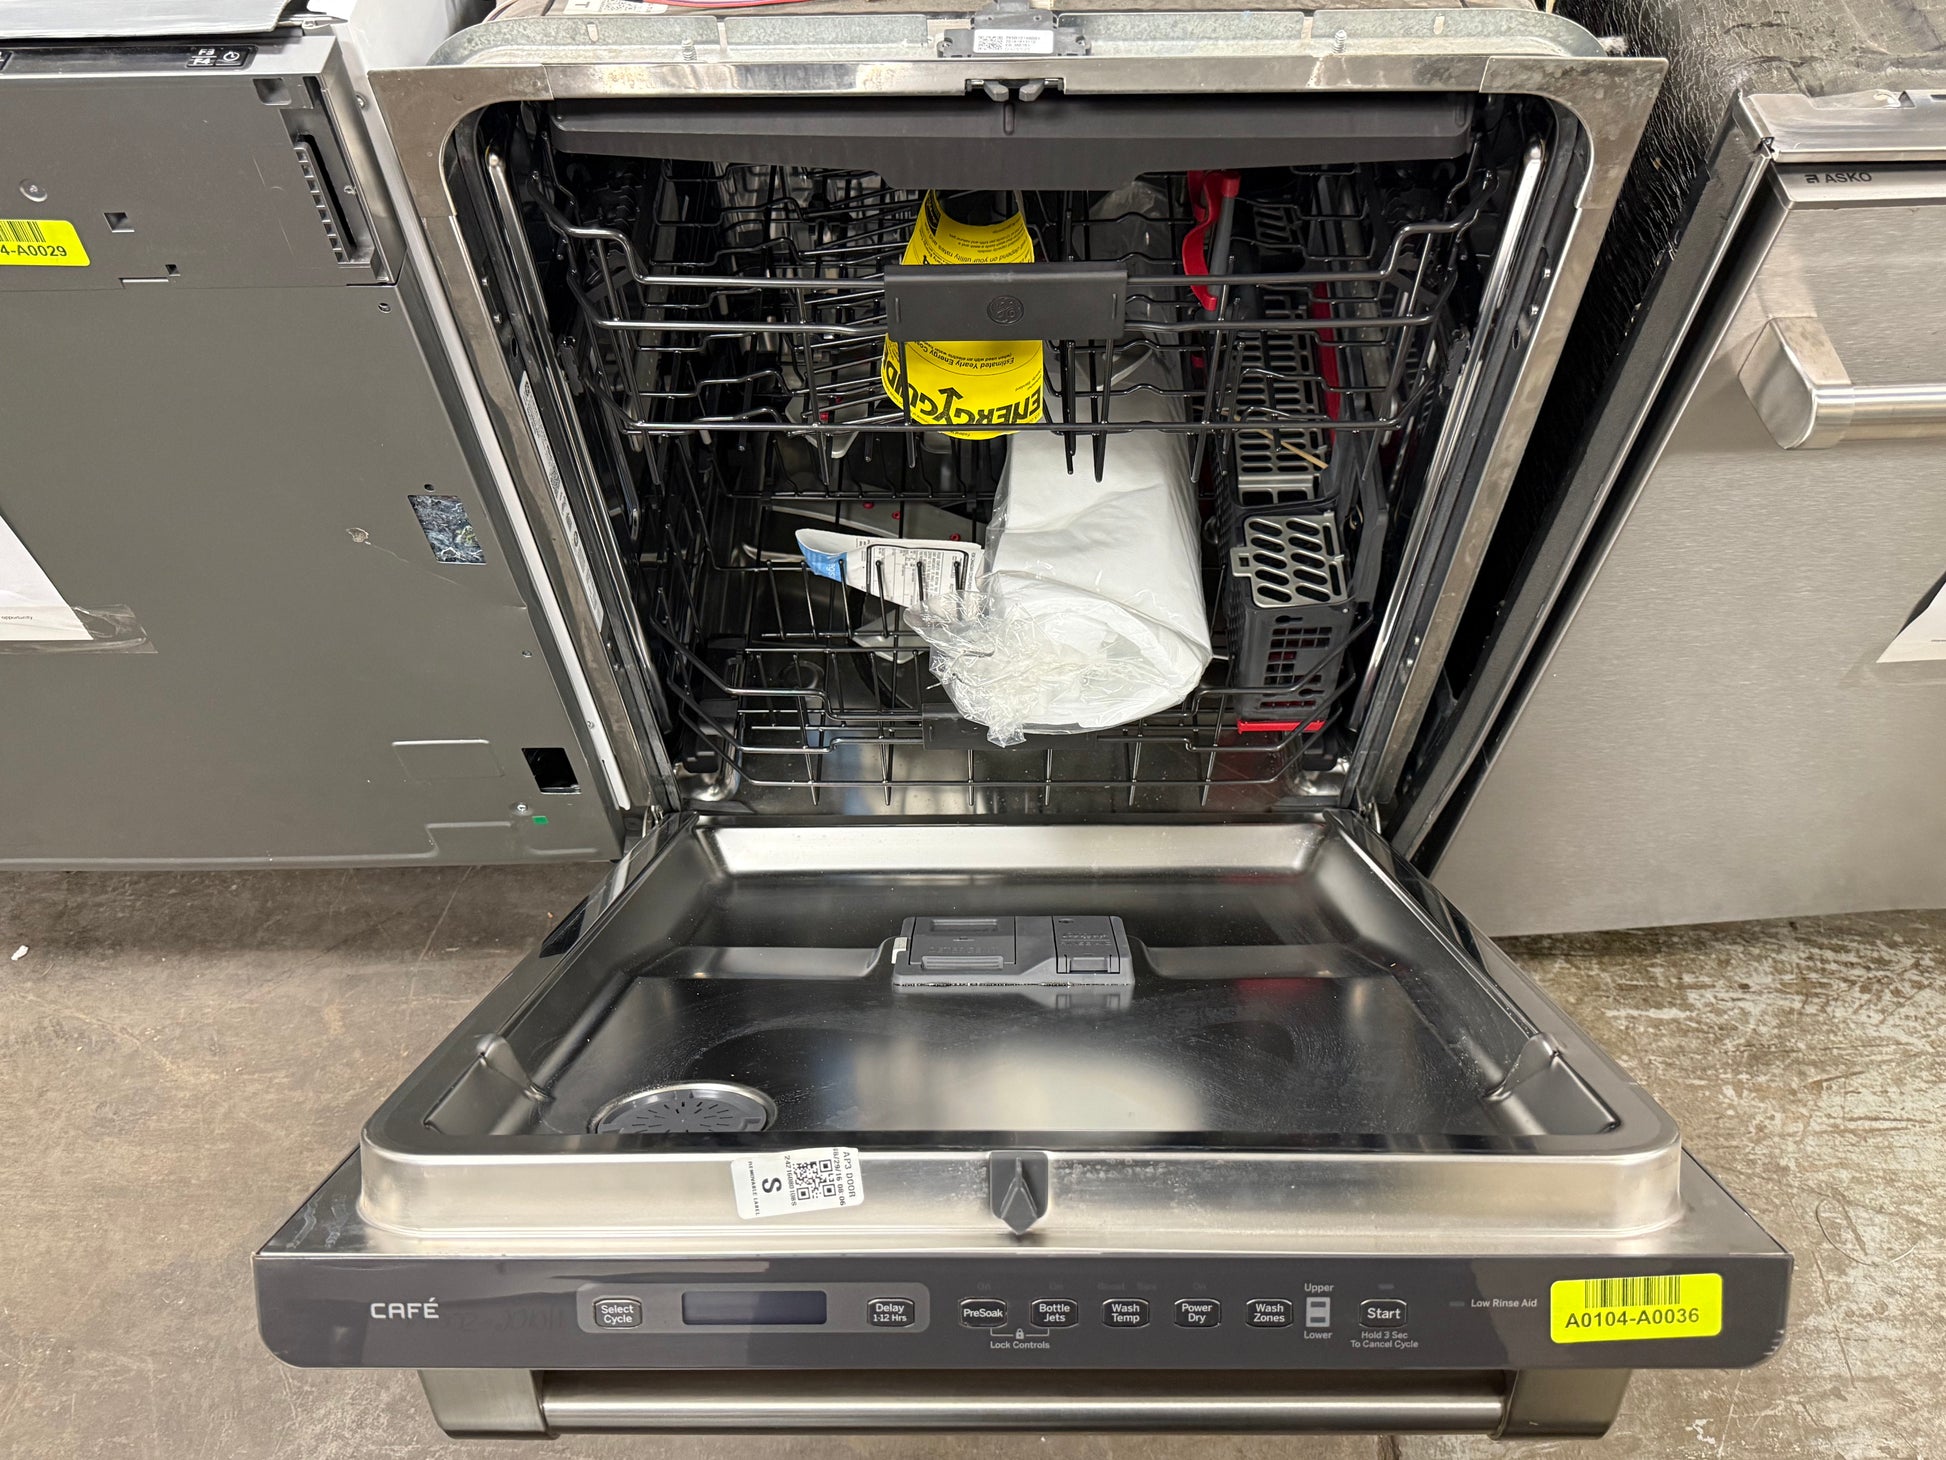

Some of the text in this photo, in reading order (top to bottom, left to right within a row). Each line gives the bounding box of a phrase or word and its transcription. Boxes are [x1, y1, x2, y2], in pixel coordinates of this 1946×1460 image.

[1825, 172, 1873, 183] ASKO
[954, 254, 972, 264] utility
[929, 349, 954, 366] Energy
[955, 359, 978, 369] Yearly
[980, 357, 1015, 369] Estimated
[884, 352, 1041, 425] ENERGYGUID
[843, 1151, 857, 1198] AP3 DOOR
[748, 1161, 761, 1216] REMOVABLE LABEL
[761, 1177, 783, 1193] S
[1304, 1283, 1334, 1293] Upper
[1181, 1303, 1213, 1312] Power
[1255, 1303, 1284, 1312] Wash
[1471, 1298, 1537, 1307] Low Rinse Aid
[370, 1297, 440, 1319] CAFÉ
[601, 1305, 634, 1314] Select
[875, 1303, 905, 1313] Delay
[963, 1308, 1003, 1317] PreSoak
[1039, 1303, 1071, 1313] Bottle
[1111, 1303, 1140, 1313] Wash
[1367, 1307, 1401, 1319] Start
[603, 1314, 633, 1326] Cycle
[891, 1314, 907, 1322] Hrs
[1043, 1313, 1066, 1322] Jets
[1111, 1313, 1140, 1324] Temp
[1188, 1313, 1206, 1323] Dry
[1253, 1313, 1285, 1322] Zones
[1564, 1308, 1700, 1328] A0104-A0036
[1303, 1331, 1333, 1339] Lower
[1361, 1331, 1408, 1339] Hold 3 Sec
[990, 1341, 1050, 1349] Lock Controls
[1350, 1340, 1419, 1349] To Cancel Cycle
